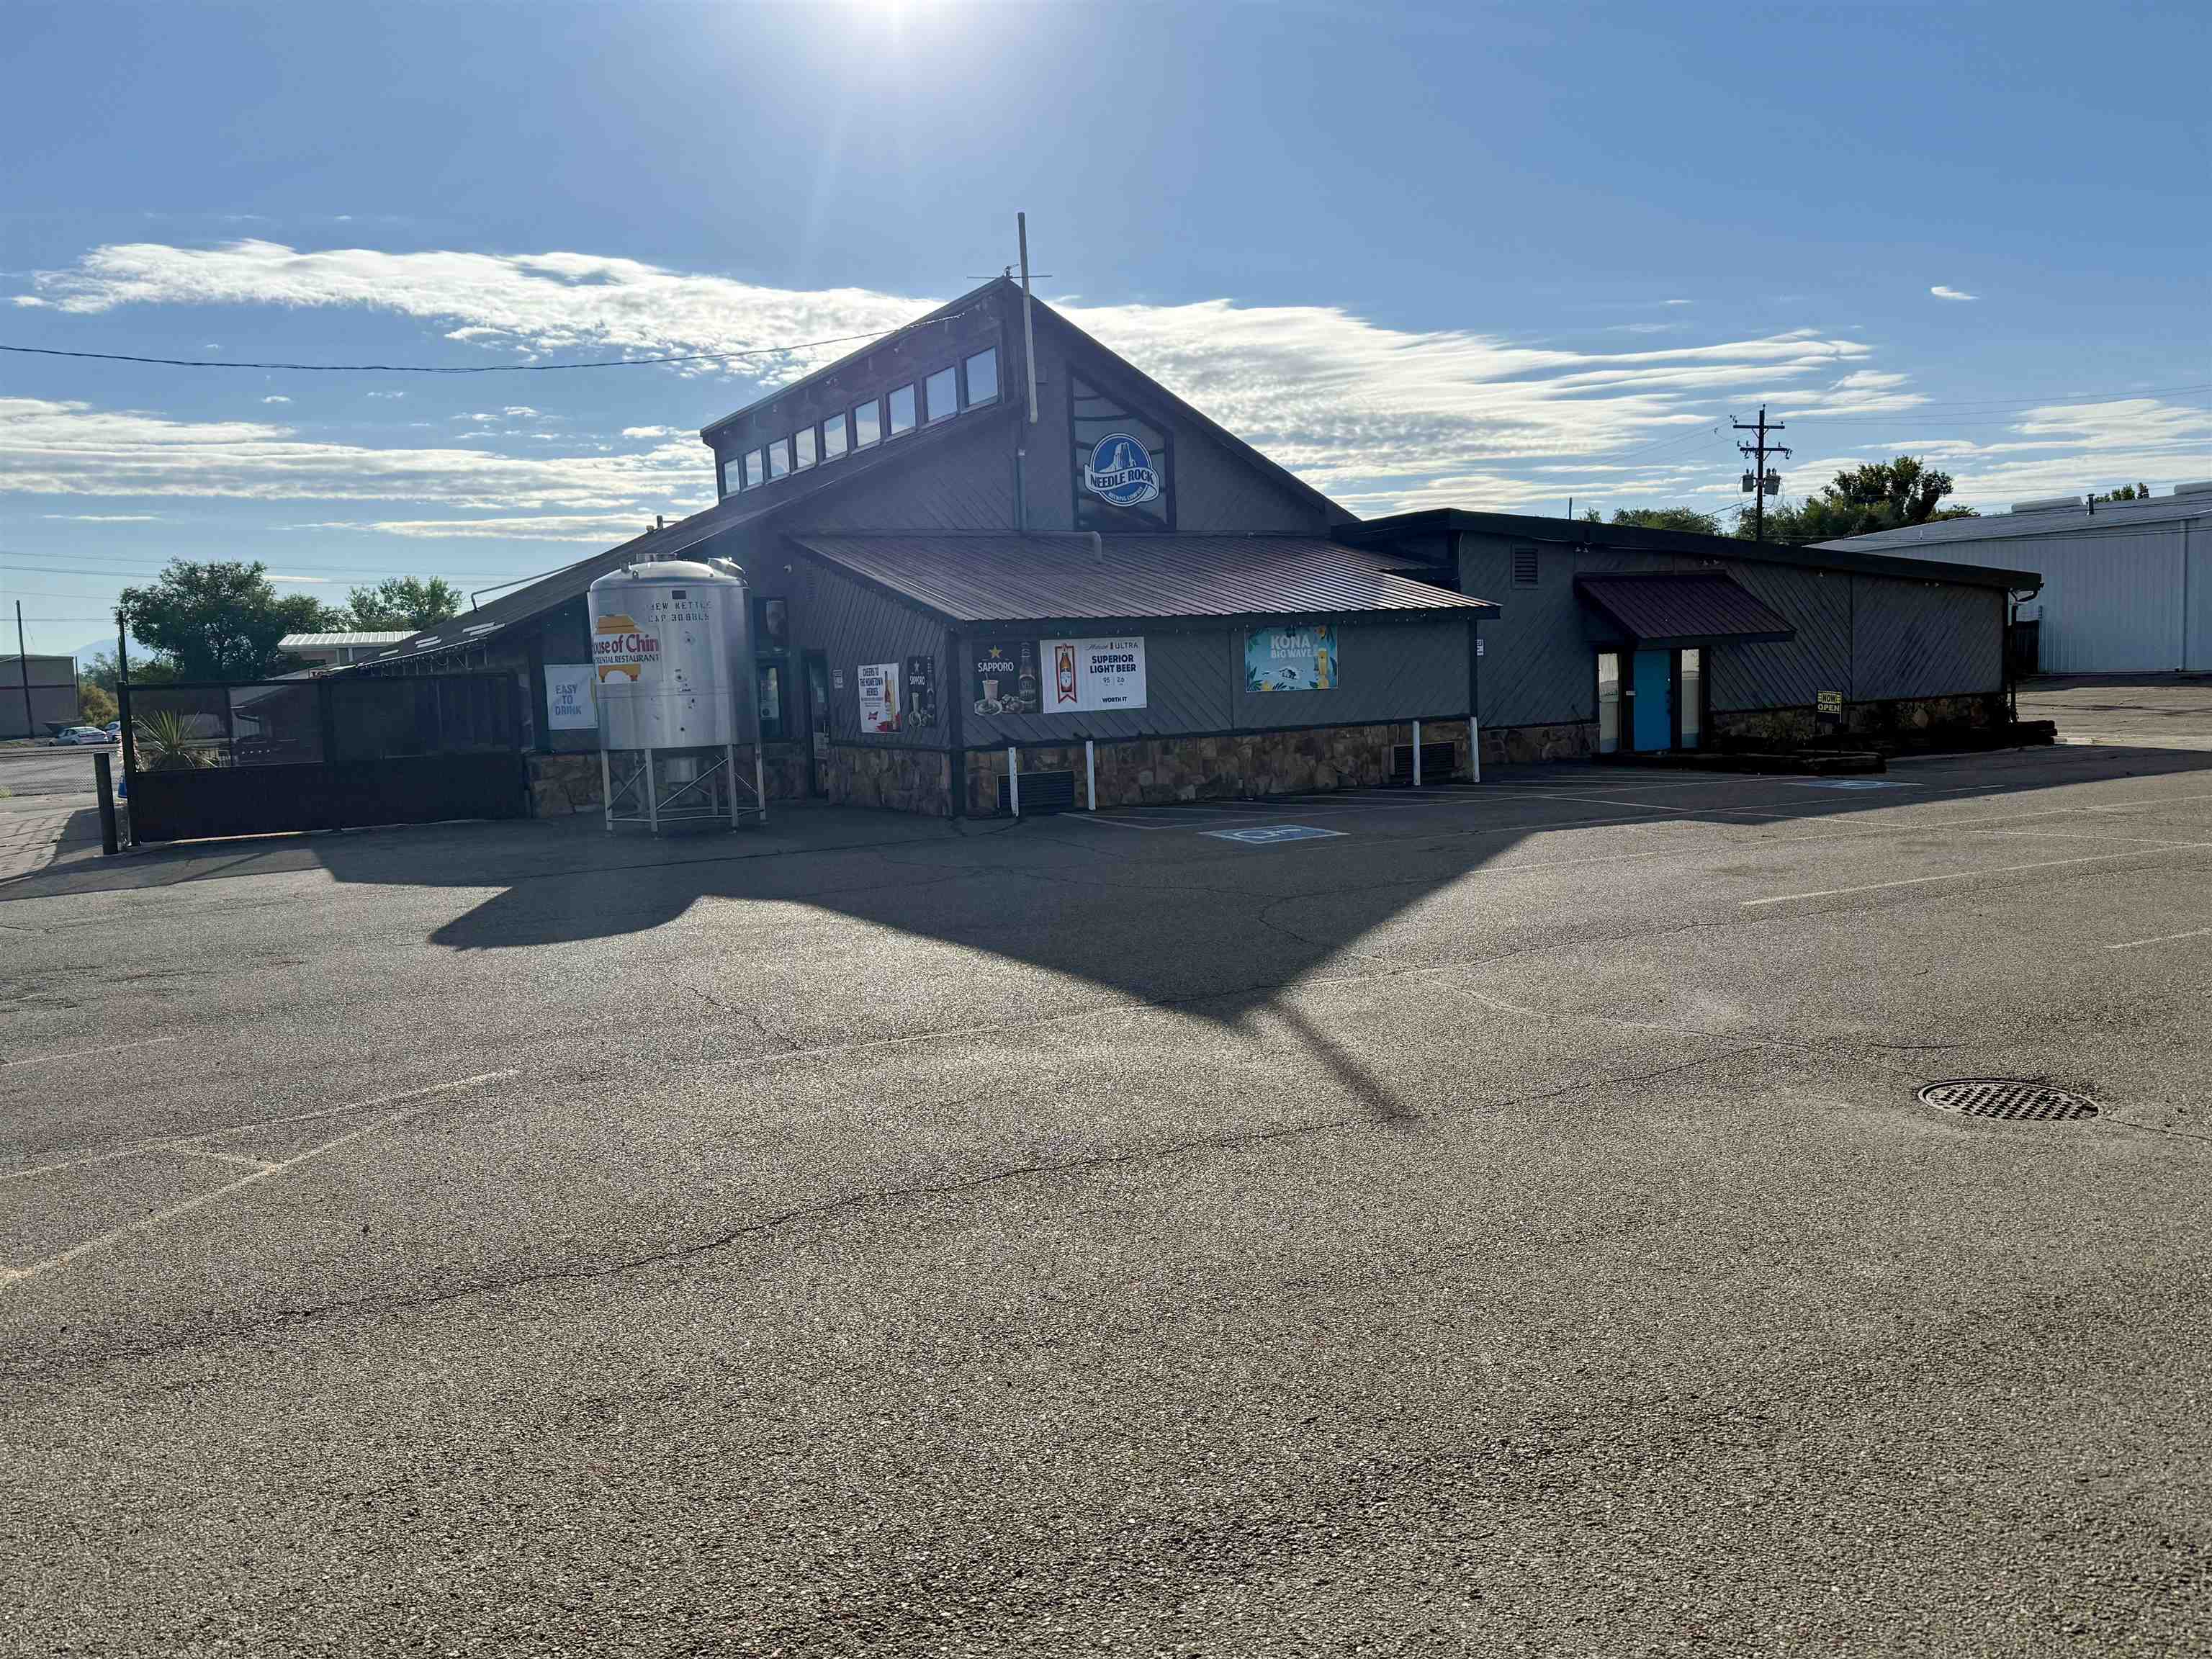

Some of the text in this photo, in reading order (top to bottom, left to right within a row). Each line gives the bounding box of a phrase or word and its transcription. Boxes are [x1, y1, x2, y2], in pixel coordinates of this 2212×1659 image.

[1090, 469, 1154, 488] NEEDLE ROCK
[593, 634, 660, 654] ouse of Chin
[1271, 634, 1311, 649] KONA
[615, 654, 659, 663] RESTAURANT
[1271, 649, 1311, 658] BIG WAVE
[1092, 654, 1134, 664] SUPERIOR
[978, 662, 1014, 672] SAPPORO
[1090, 664, 1136, 673] LIGHT BEER
[555, 684, 577, 694] EASY
[562, 695, 573, 704] TO
[555, 705, 582, 715] DRINK
